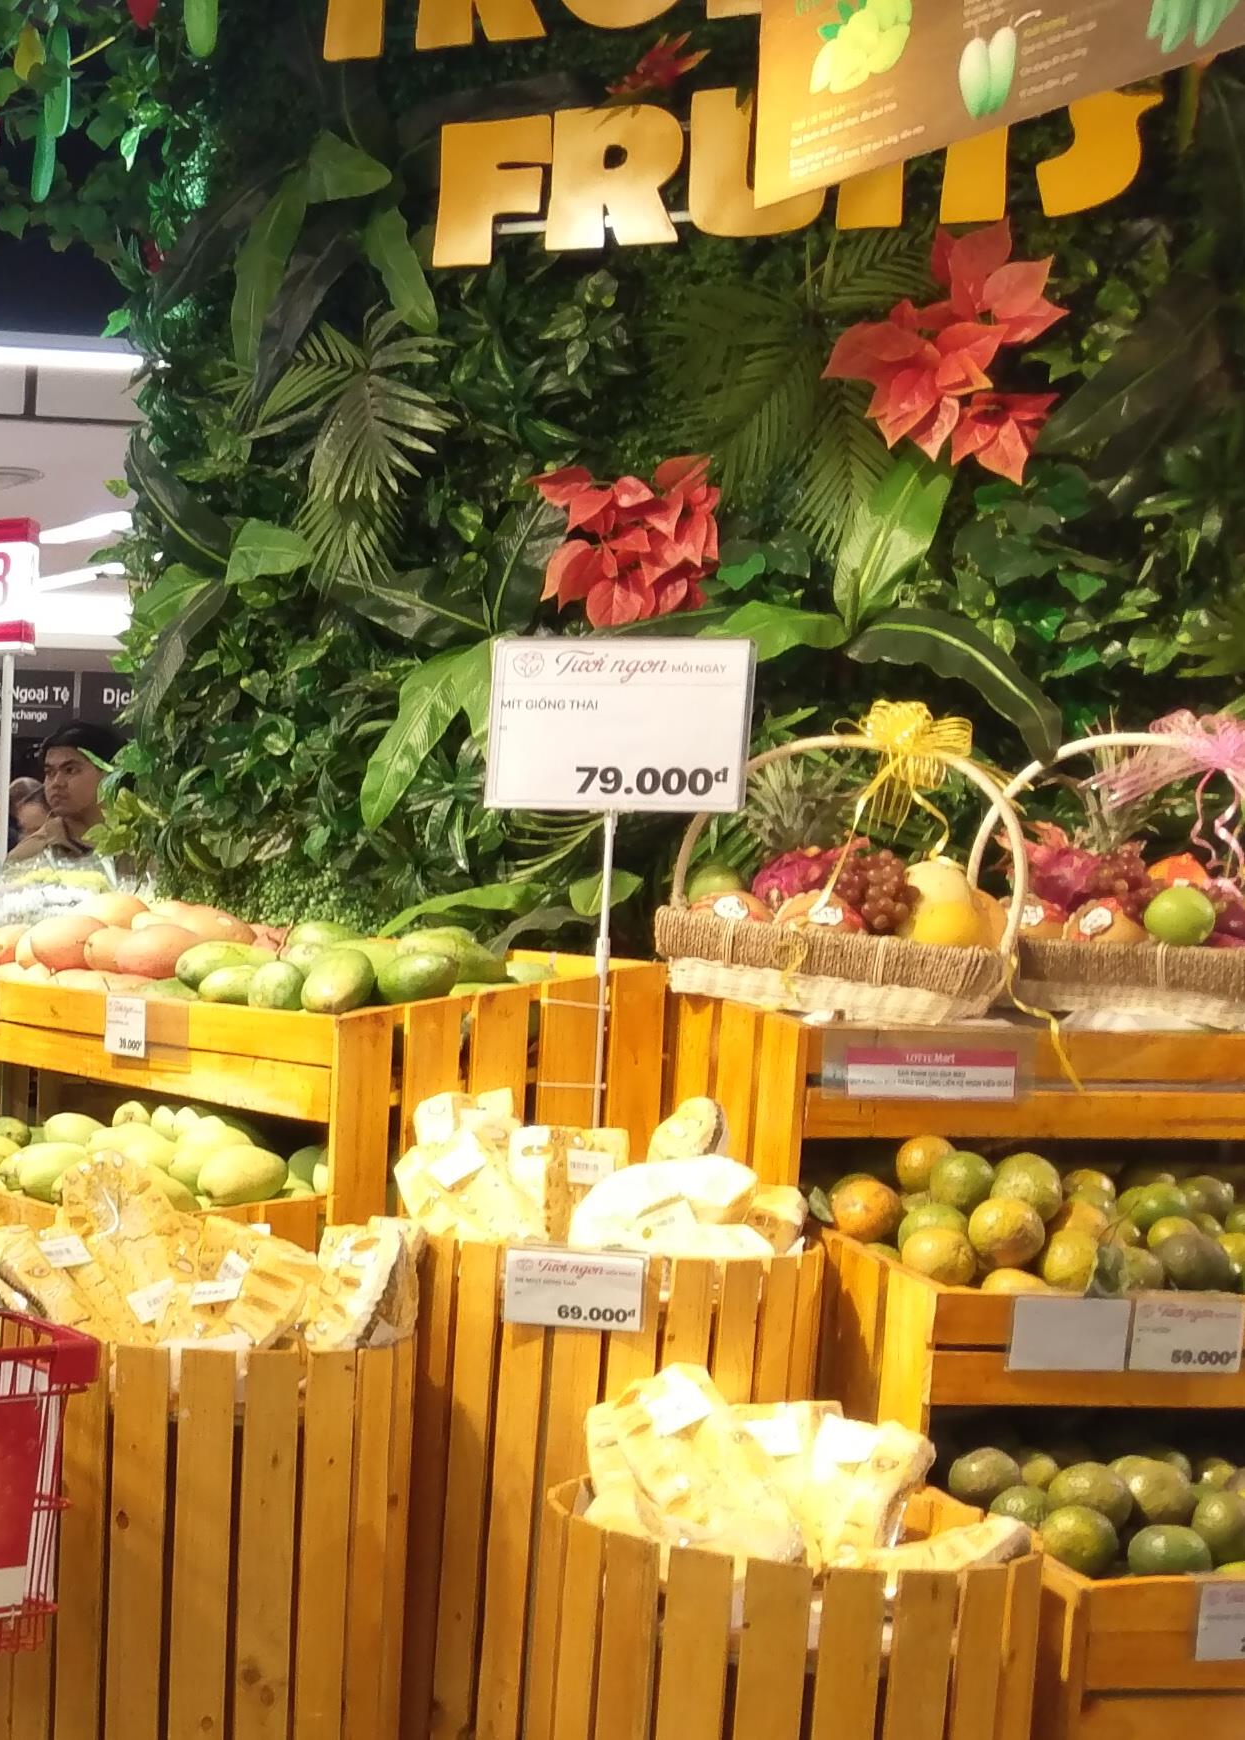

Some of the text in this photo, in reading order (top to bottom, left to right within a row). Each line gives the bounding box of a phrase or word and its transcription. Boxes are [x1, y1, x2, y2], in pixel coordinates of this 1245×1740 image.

[555, 649, 609, 677] Tươi
[610, 658, 671, 684] ngon
[11, 685, 49, 704] Ngoại
[52, 686, 70, 705] Tệ
[12, 708, 48, 723] xchange
[575, 765, 729, 796] 79.000đ
[570, 1263, 604, 1280] ngon
